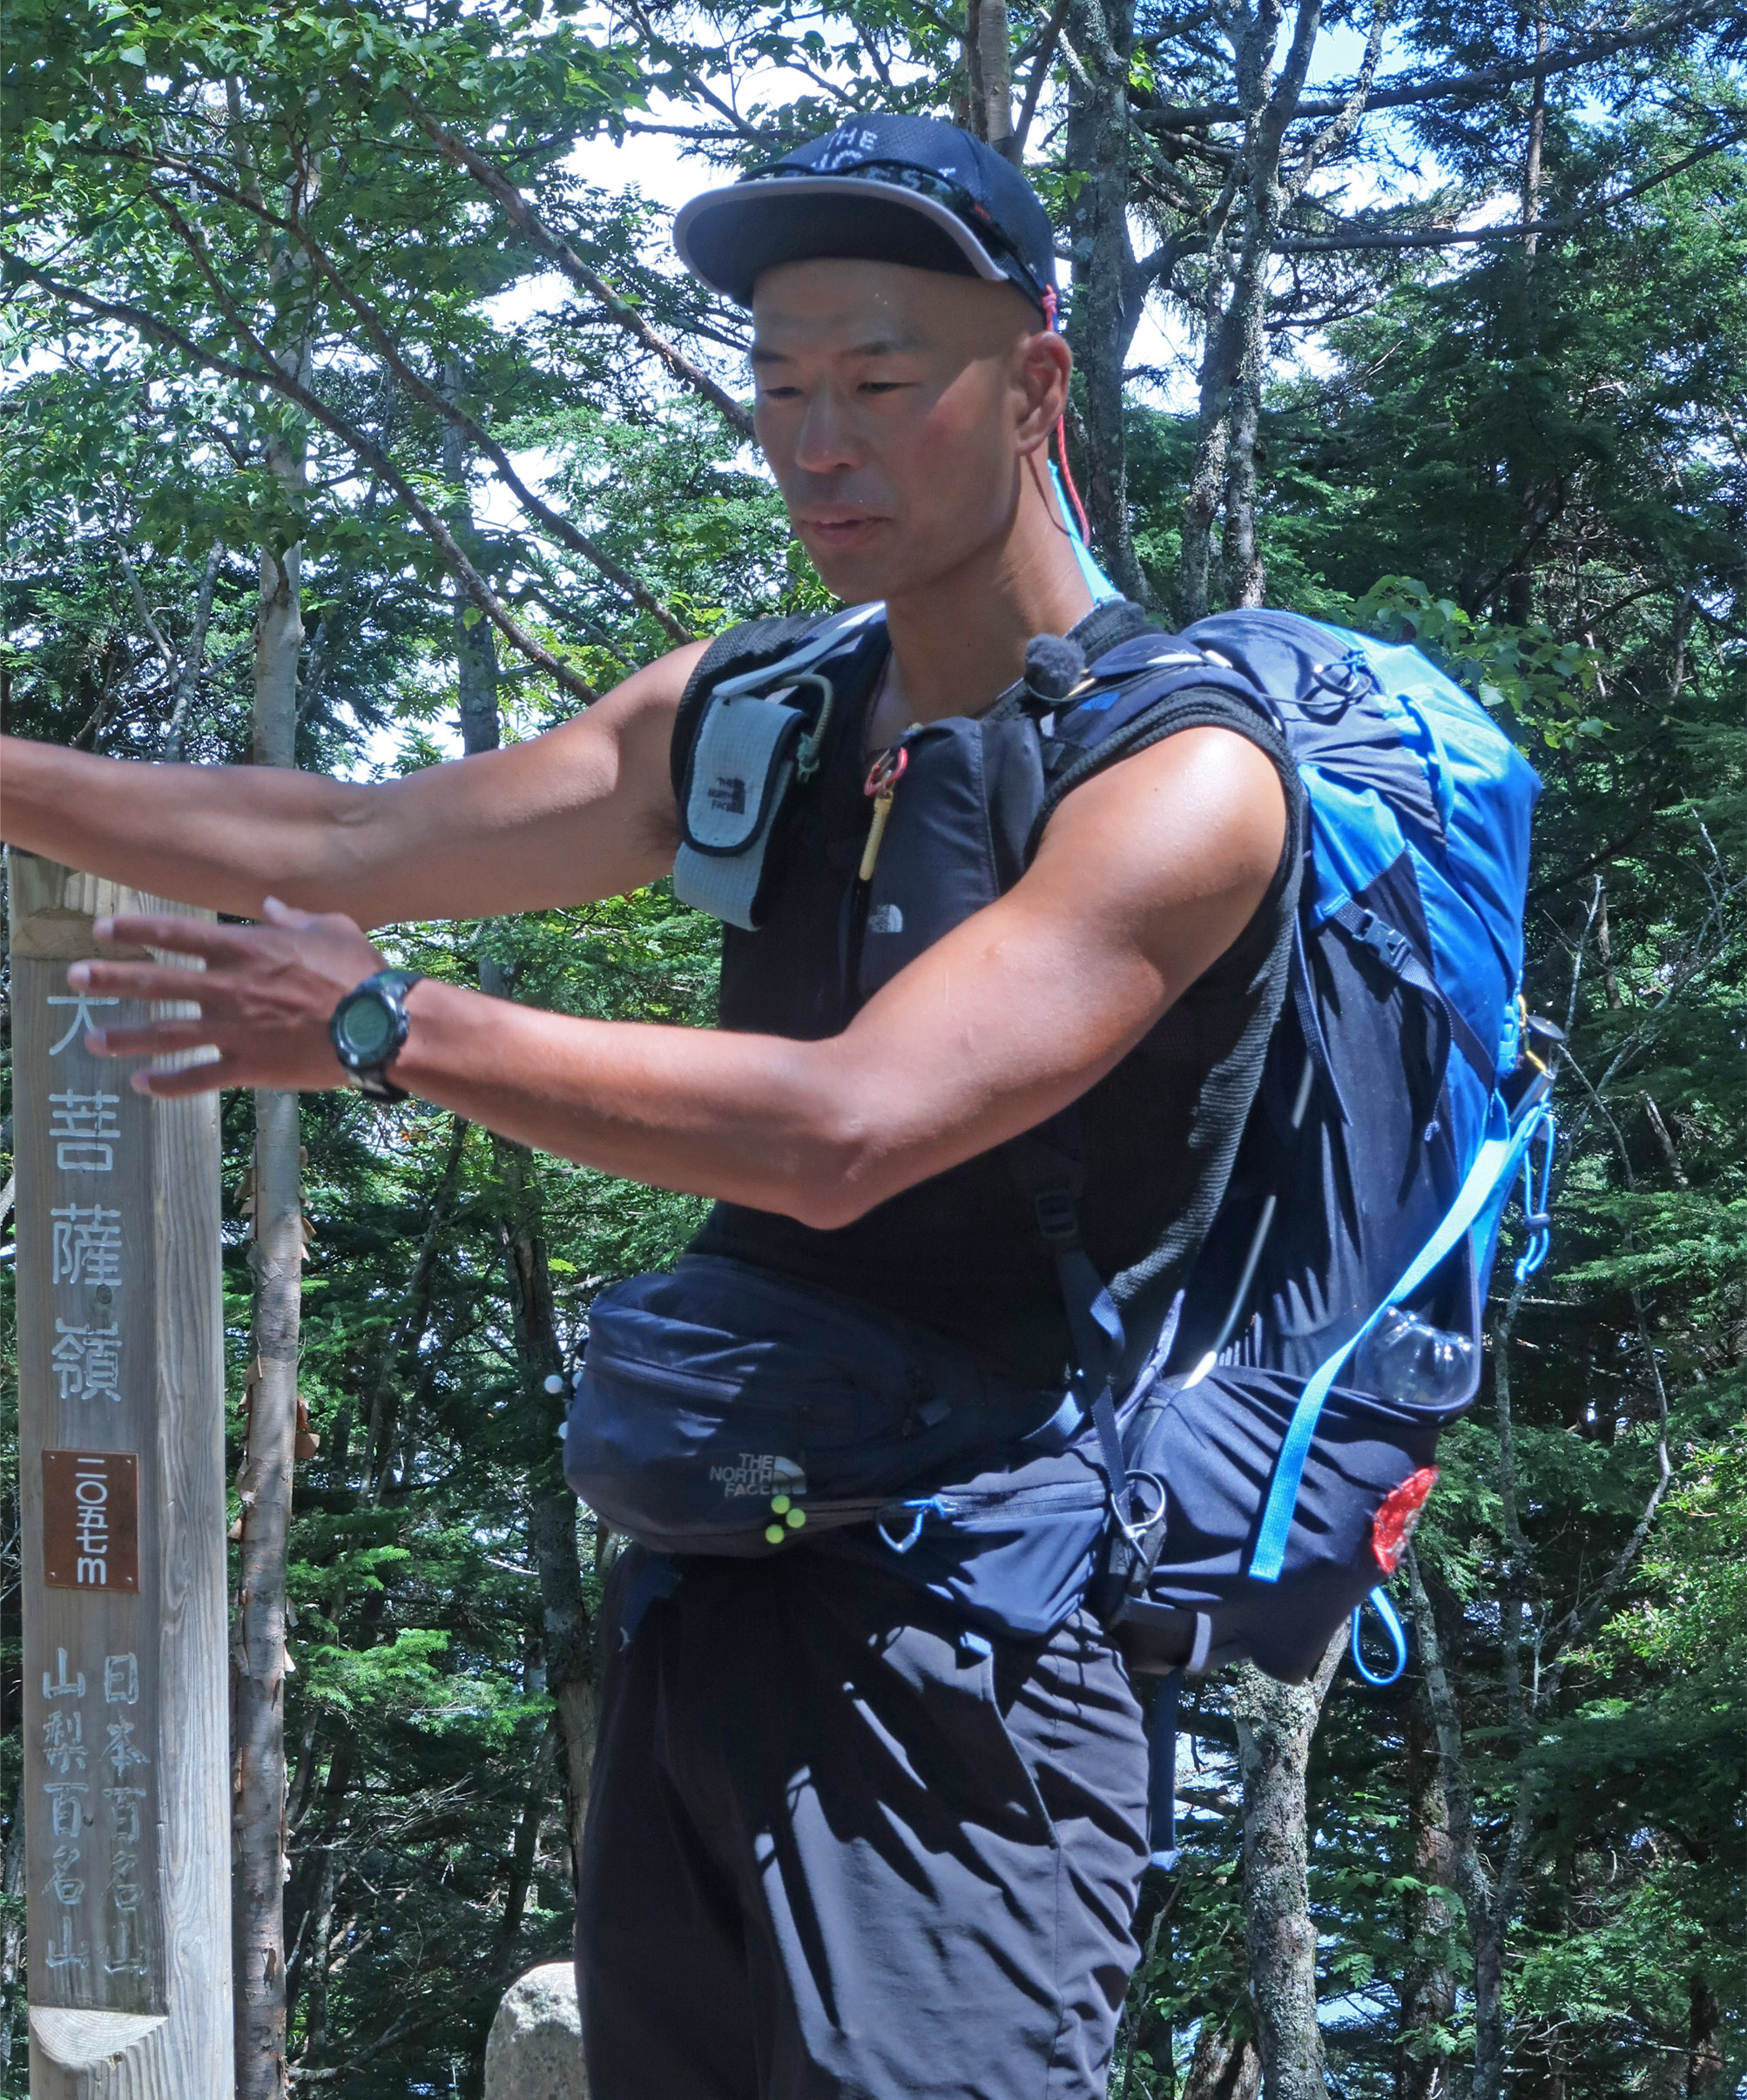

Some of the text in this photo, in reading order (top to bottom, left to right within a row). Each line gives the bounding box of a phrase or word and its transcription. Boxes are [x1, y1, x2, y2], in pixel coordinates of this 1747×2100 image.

[46, 989, 122, 1403] 大菩薩嶺
[708, 1464, 773, 1484] NORTH
[724, 1482, 772, 1498] FACE
[739, 1452, 775, 1471] THE
[42, 1646, 89, 1969] 山梨百名山
[98, 1651, 152, 1975] 日本百名山
